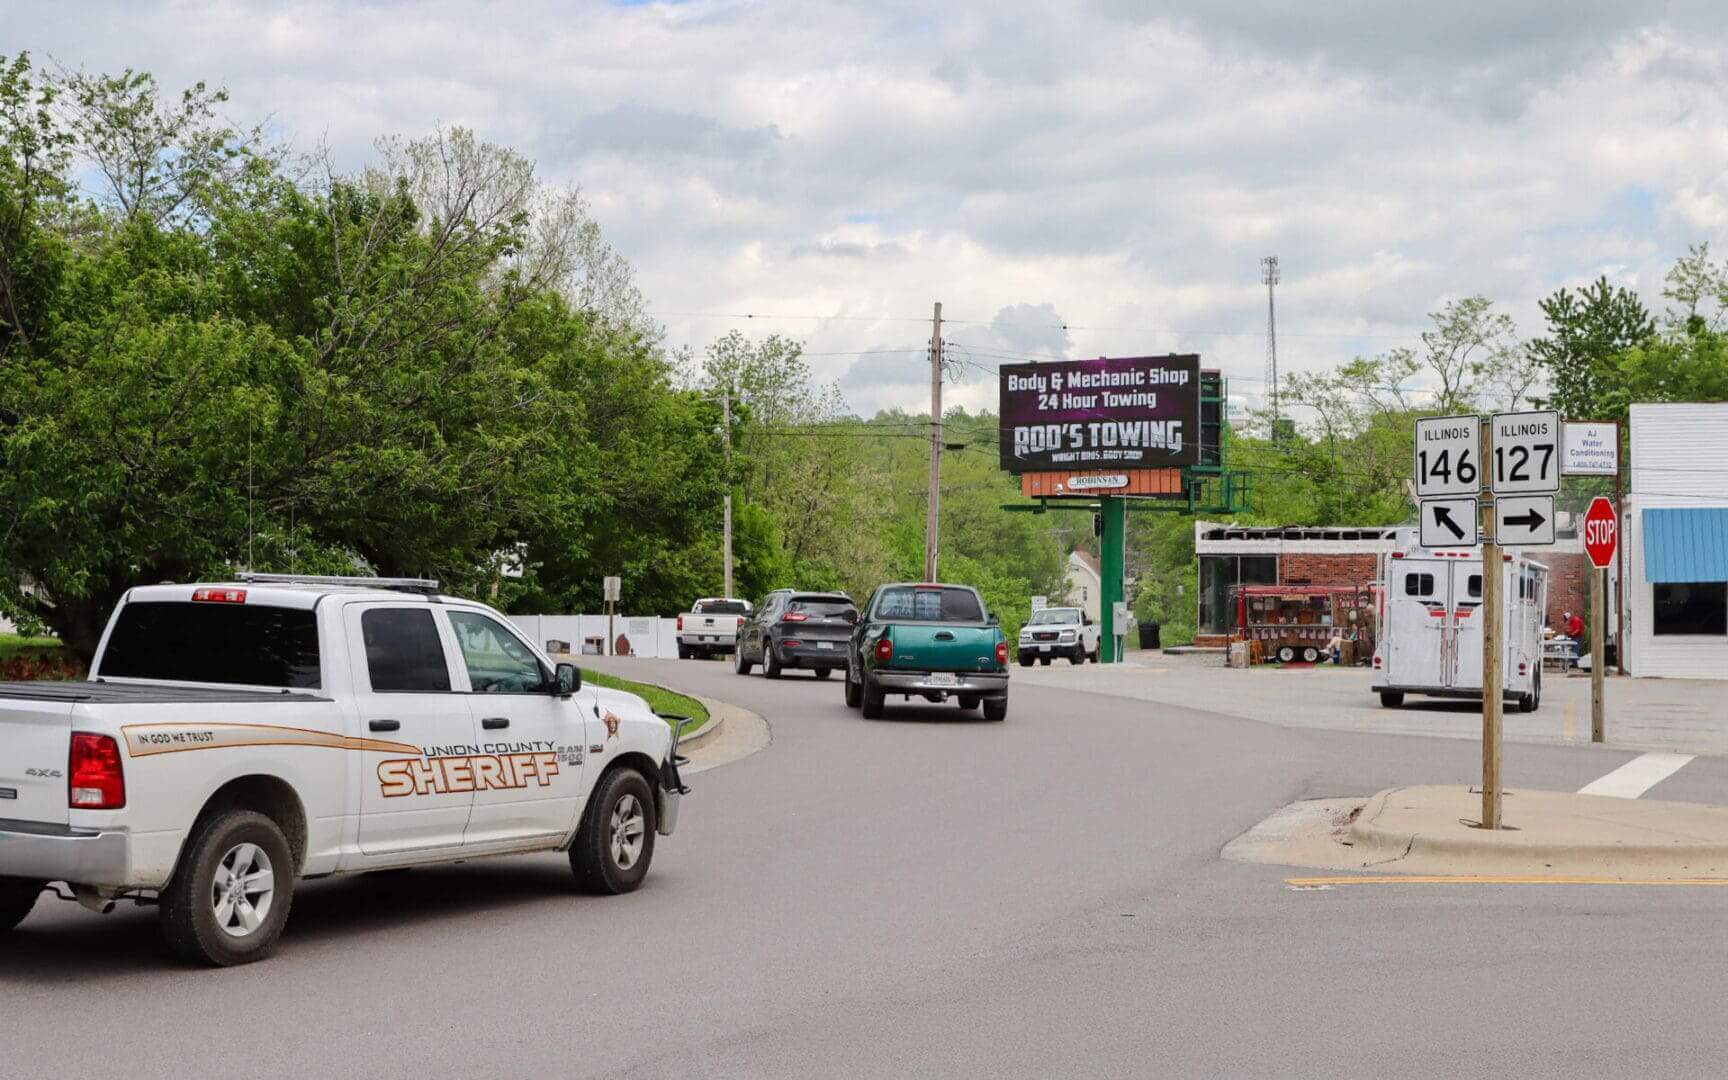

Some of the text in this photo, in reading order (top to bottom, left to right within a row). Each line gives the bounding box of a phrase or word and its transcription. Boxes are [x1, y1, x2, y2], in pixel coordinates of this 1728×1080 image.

[1008, 367, 1189, 393] Body & Mechanic Shop
[1038, 389, 1157, 411] 24 Hour Towing
[1014, 420, 1183, 459] ROD'S TOWING
[1424, 427, 1470, 441] ILLINOIS
[1501, 423, 1548, 437] ILLINOIS
[1570, 448, 1615, 459] Conditioning
[1582, 439, 1602, 447] Water
[1418, 448, 1477, 486] 146
[1495, 444, 1554, 482] 127
[1587, 519, 1615, 545] STOP
[138, 731, 214, 744] IN GOD WE TRUST
[423, 741, 555, 757] UNION COUNTY
[377, 751, 560, 798] SHERIFF
